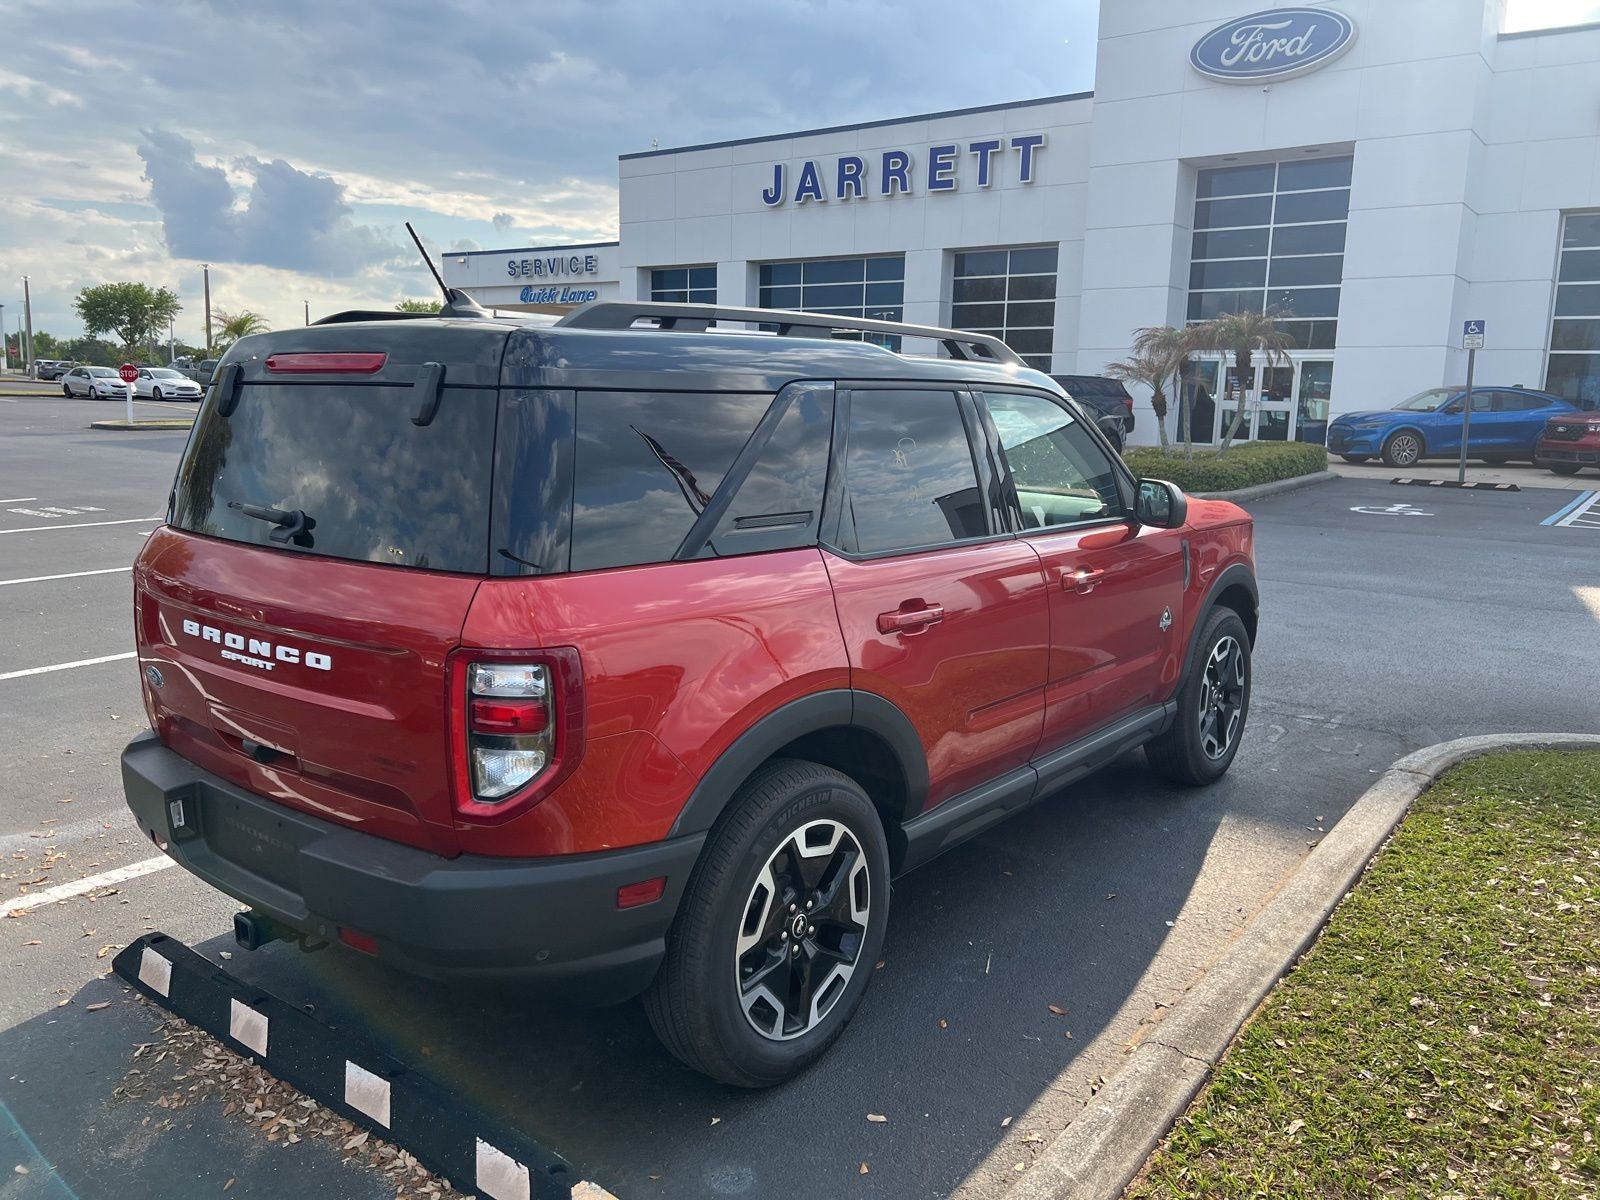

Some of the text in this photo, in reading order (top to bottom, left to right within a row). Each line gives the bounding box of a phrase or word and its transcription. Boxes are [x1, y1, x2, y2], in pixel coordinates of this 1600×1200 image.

[1220, 19, 1317, 67] Ford
[761, 134, 1047, 207] JARRETT
[507, 255, 597, 277] SERVICE
[520, 285, 597, 304] Quick Lane
[120, 370, 138, 378] STOP
[182, 618, 332, 671] BRONCO
[220, 649, 276, 671] SPORT
[778, 791, 831, 824] MICHELIN
